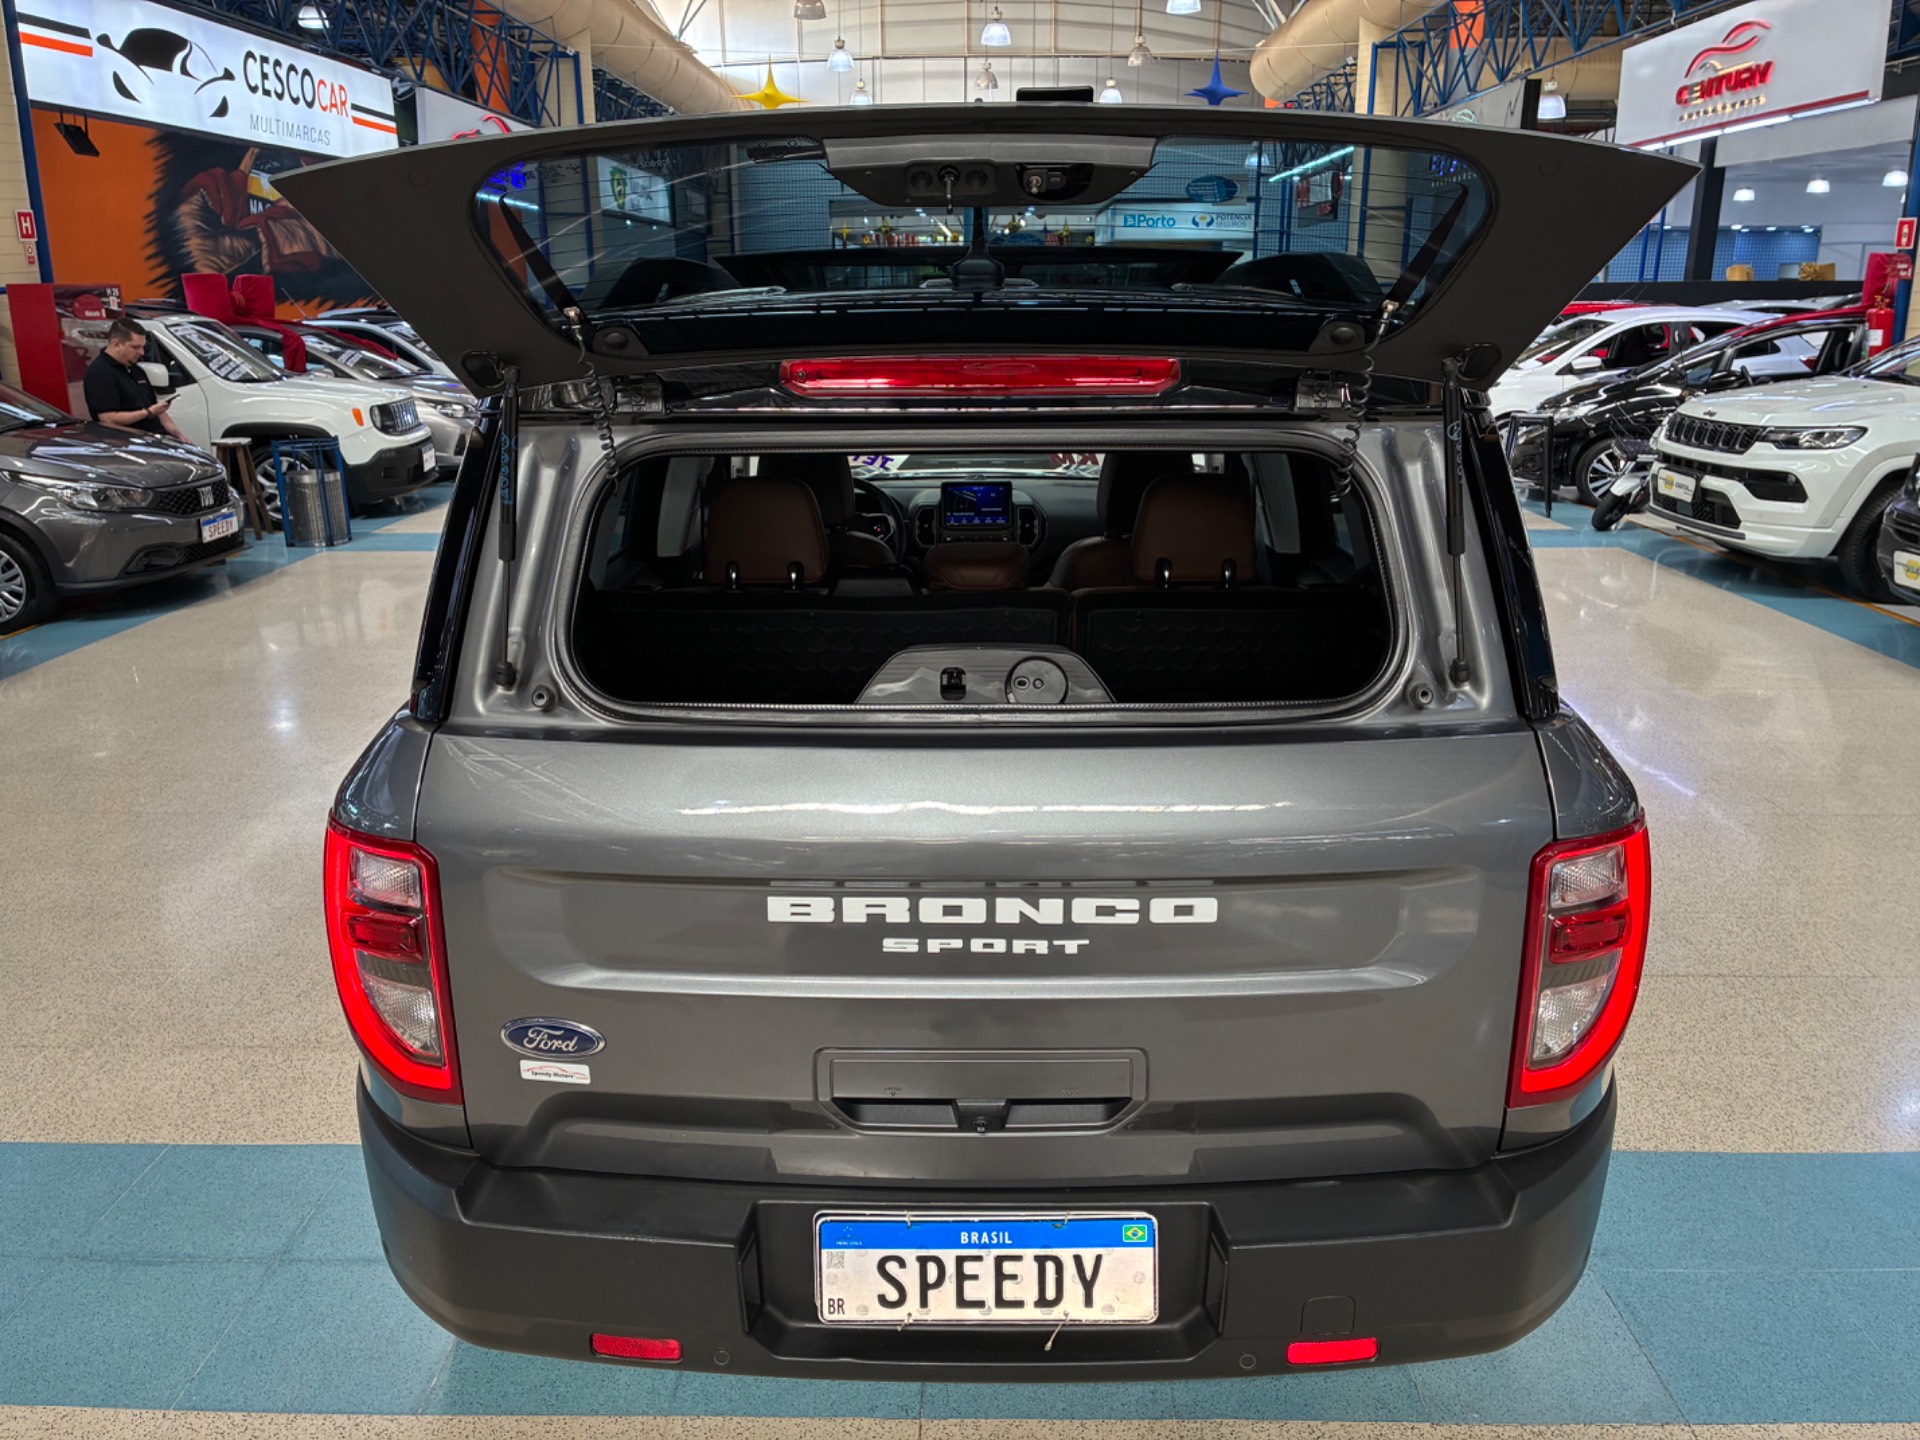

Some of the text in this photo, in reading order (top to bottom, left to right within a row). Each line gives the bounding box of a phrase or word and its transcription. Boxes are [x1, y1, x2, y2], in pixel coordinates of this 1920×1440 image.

[243, 50, 349, 118] CESCOCAR
[1675, 60, 1774, 106] CENTURY
[250, 113, 331, 147] MULTIMARCAS
[21, 215, 32, 235] H
[1137, 213, 1176, 227] Porto
[767, 896, 1219, 925] BRONCO
[882, 937, 1090, 955] SPORT
[523, 1026, 579, 1052] Ford
[960, 1231, 1013, 1245] BRASIL
[876, 1253, 1104, 1310] SPEEDY
[827, 1298, 845, 1315] BR
